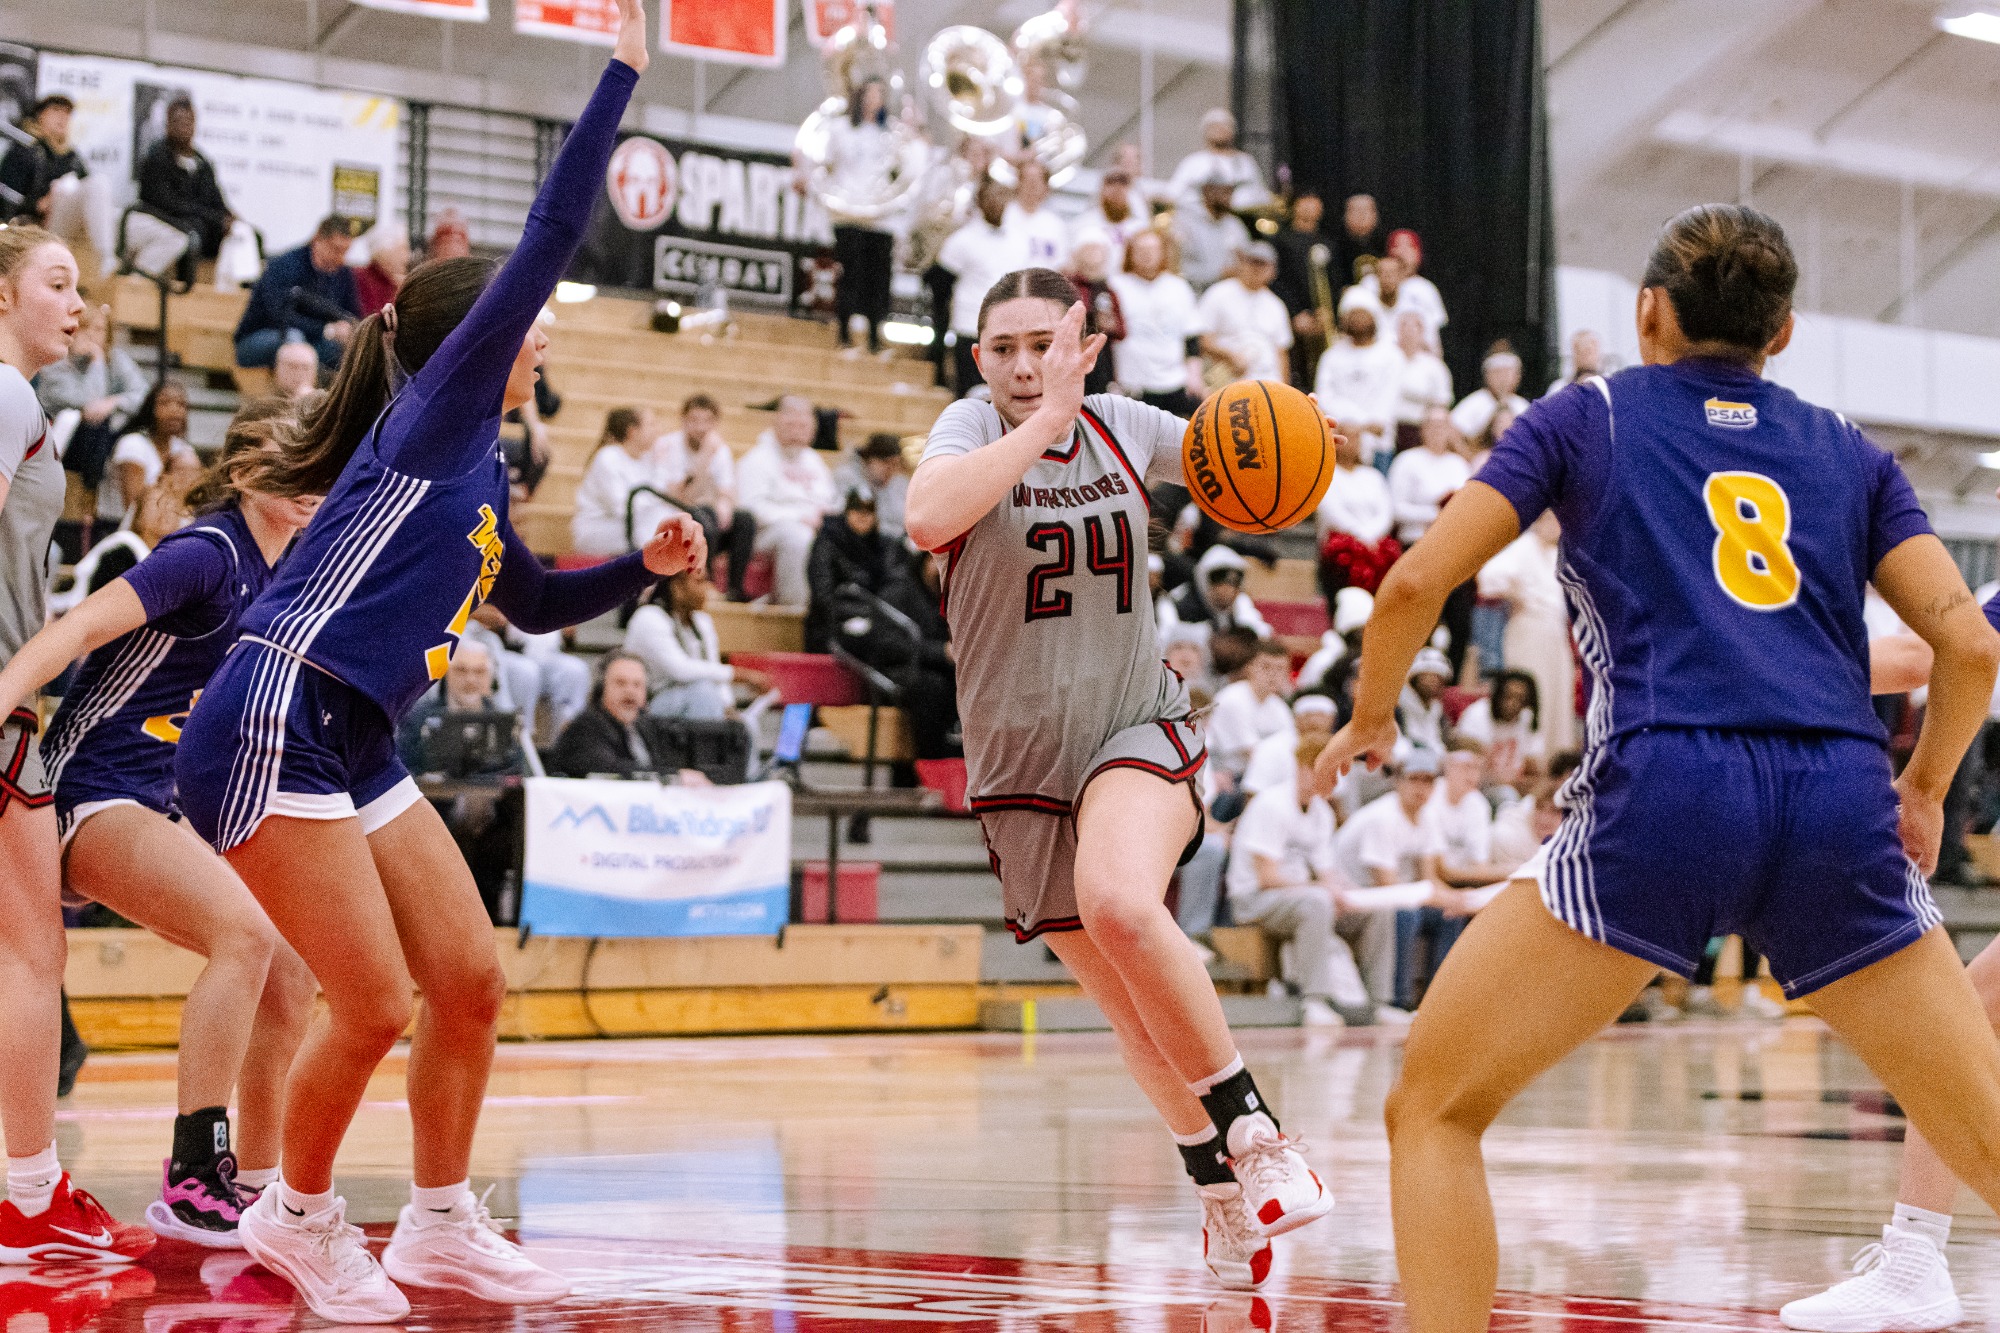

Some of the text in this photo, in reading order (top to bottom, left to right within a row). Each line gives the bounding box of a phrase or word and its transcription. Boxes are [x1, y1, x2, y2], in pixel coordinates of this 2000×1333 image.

[663, 249, 782, 292] COMBAT
[1229, 397, 1262, 471] NCAA
[1708, 408, 1755, 421] PSAC
[1189, 401, 1223, 504] Wilson
[1012, 471, 1130, 510] WARRIORS
[1024, 510, 1135, 624] 24
[1702, 470, 1801, 612] 8
